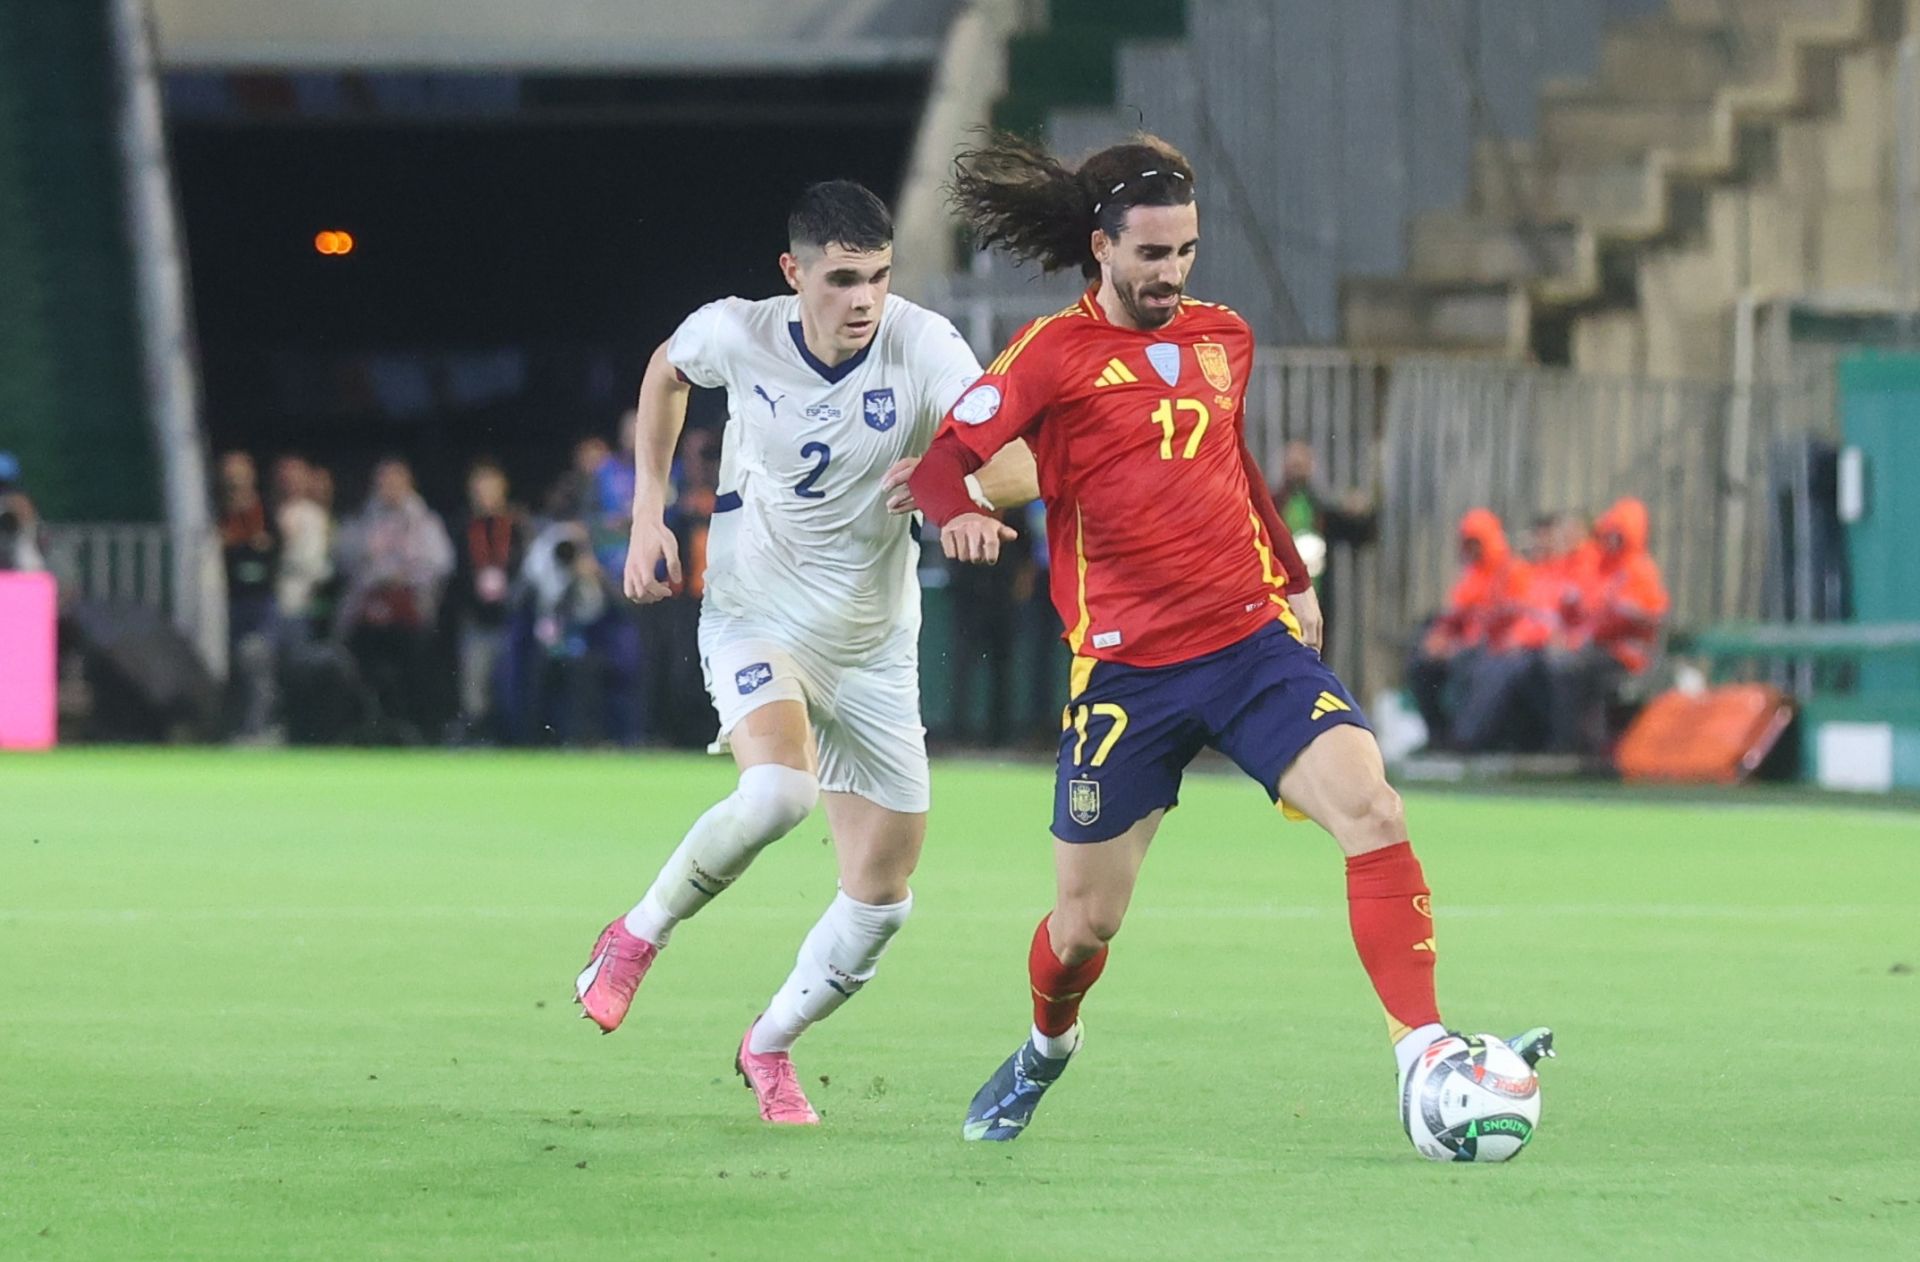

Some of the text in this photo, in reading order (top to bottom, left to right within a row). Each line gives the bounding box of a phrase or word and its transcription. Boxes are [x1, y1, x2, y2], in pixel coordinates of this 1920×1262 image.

[1151, 399, 1209, 460] 17
[795, 441, 830, 498] 2
[1073, 703, 1128, 767] 17
